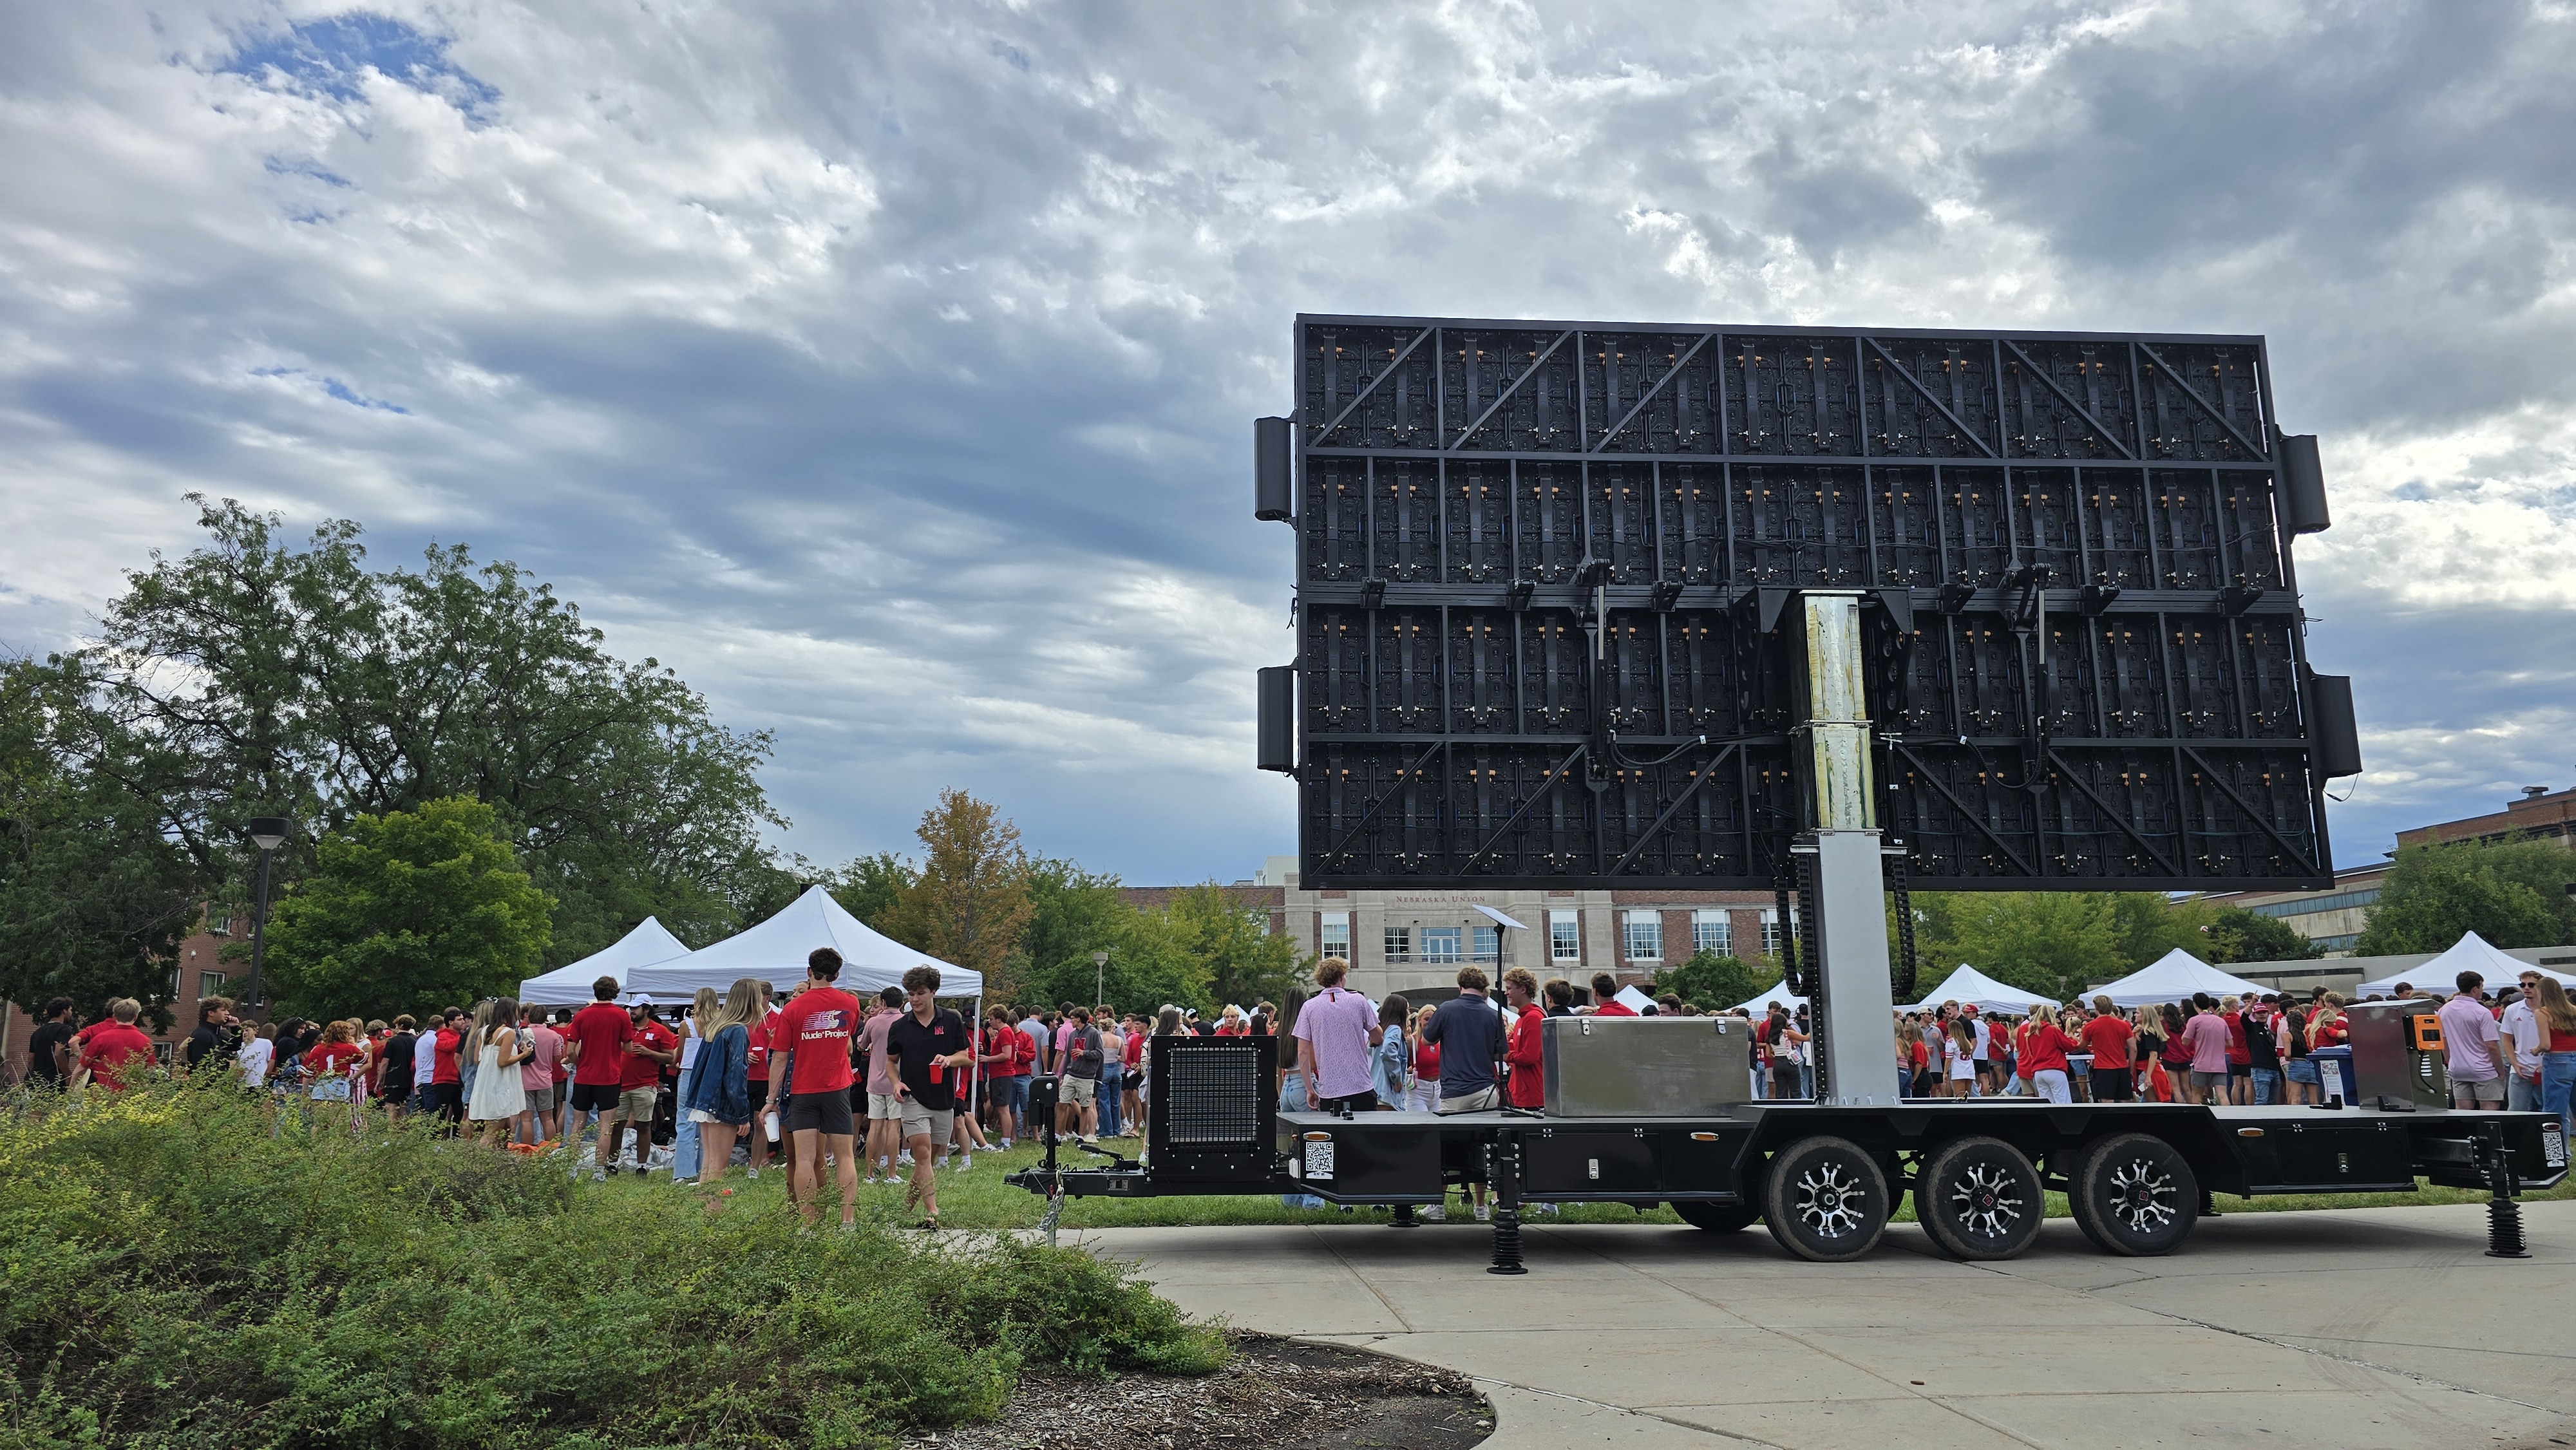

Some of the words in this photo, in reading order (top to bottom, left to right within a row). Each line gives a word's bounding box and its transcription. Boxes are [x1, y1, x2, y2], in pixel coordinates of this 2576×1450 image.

[825, 1029, 849, 1039] Project
[934, 1026, 944, 1035] N
[645, 1032, 654, 1040] N
[1074, 1037, 1086, 1050] N
